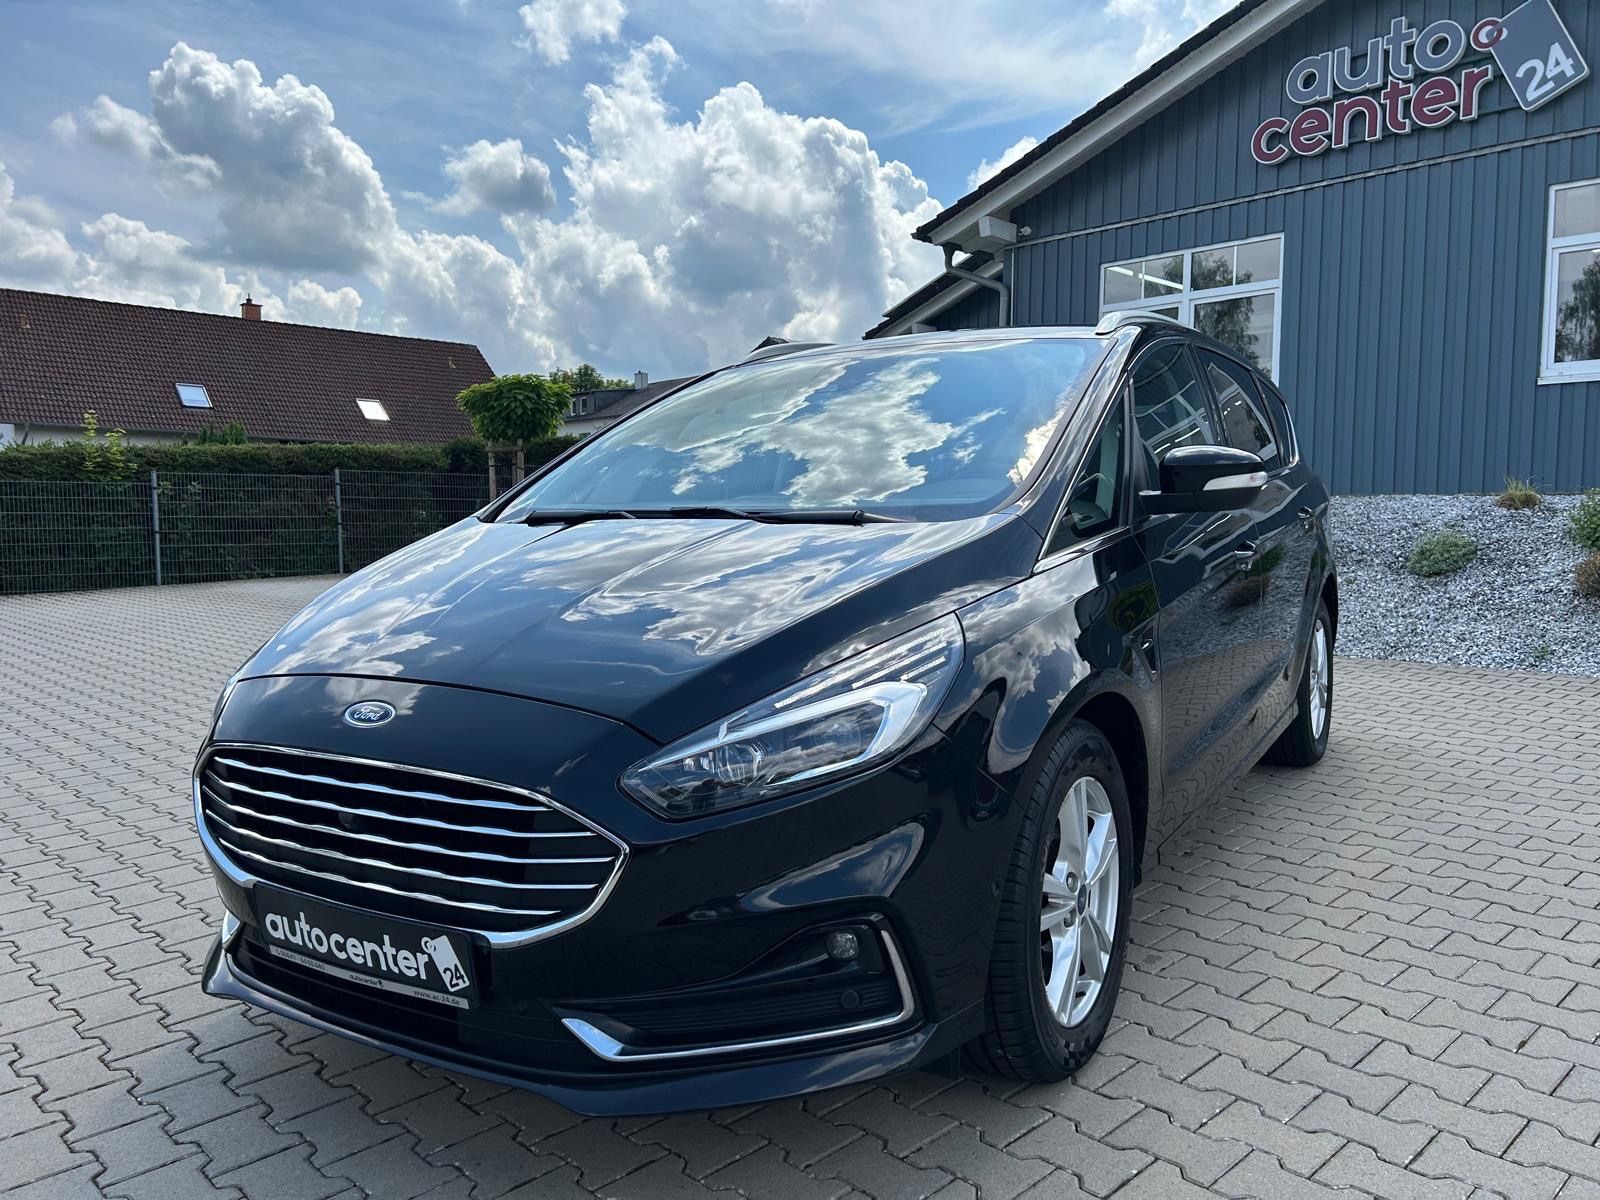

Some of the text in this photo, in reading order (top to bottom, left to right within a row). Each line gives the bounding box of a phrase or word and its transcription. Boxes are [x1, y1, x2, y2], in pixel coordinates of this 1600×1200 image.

[1286, 16, 1466, 104] auto
[1515, 42, 1577, 101] 24
[1251, 64, 1493, 165] center
[353, 705, 385, 720] Ford
[265, 911, 429, 980] autocenter
[443, 963, 466, 989] 24
